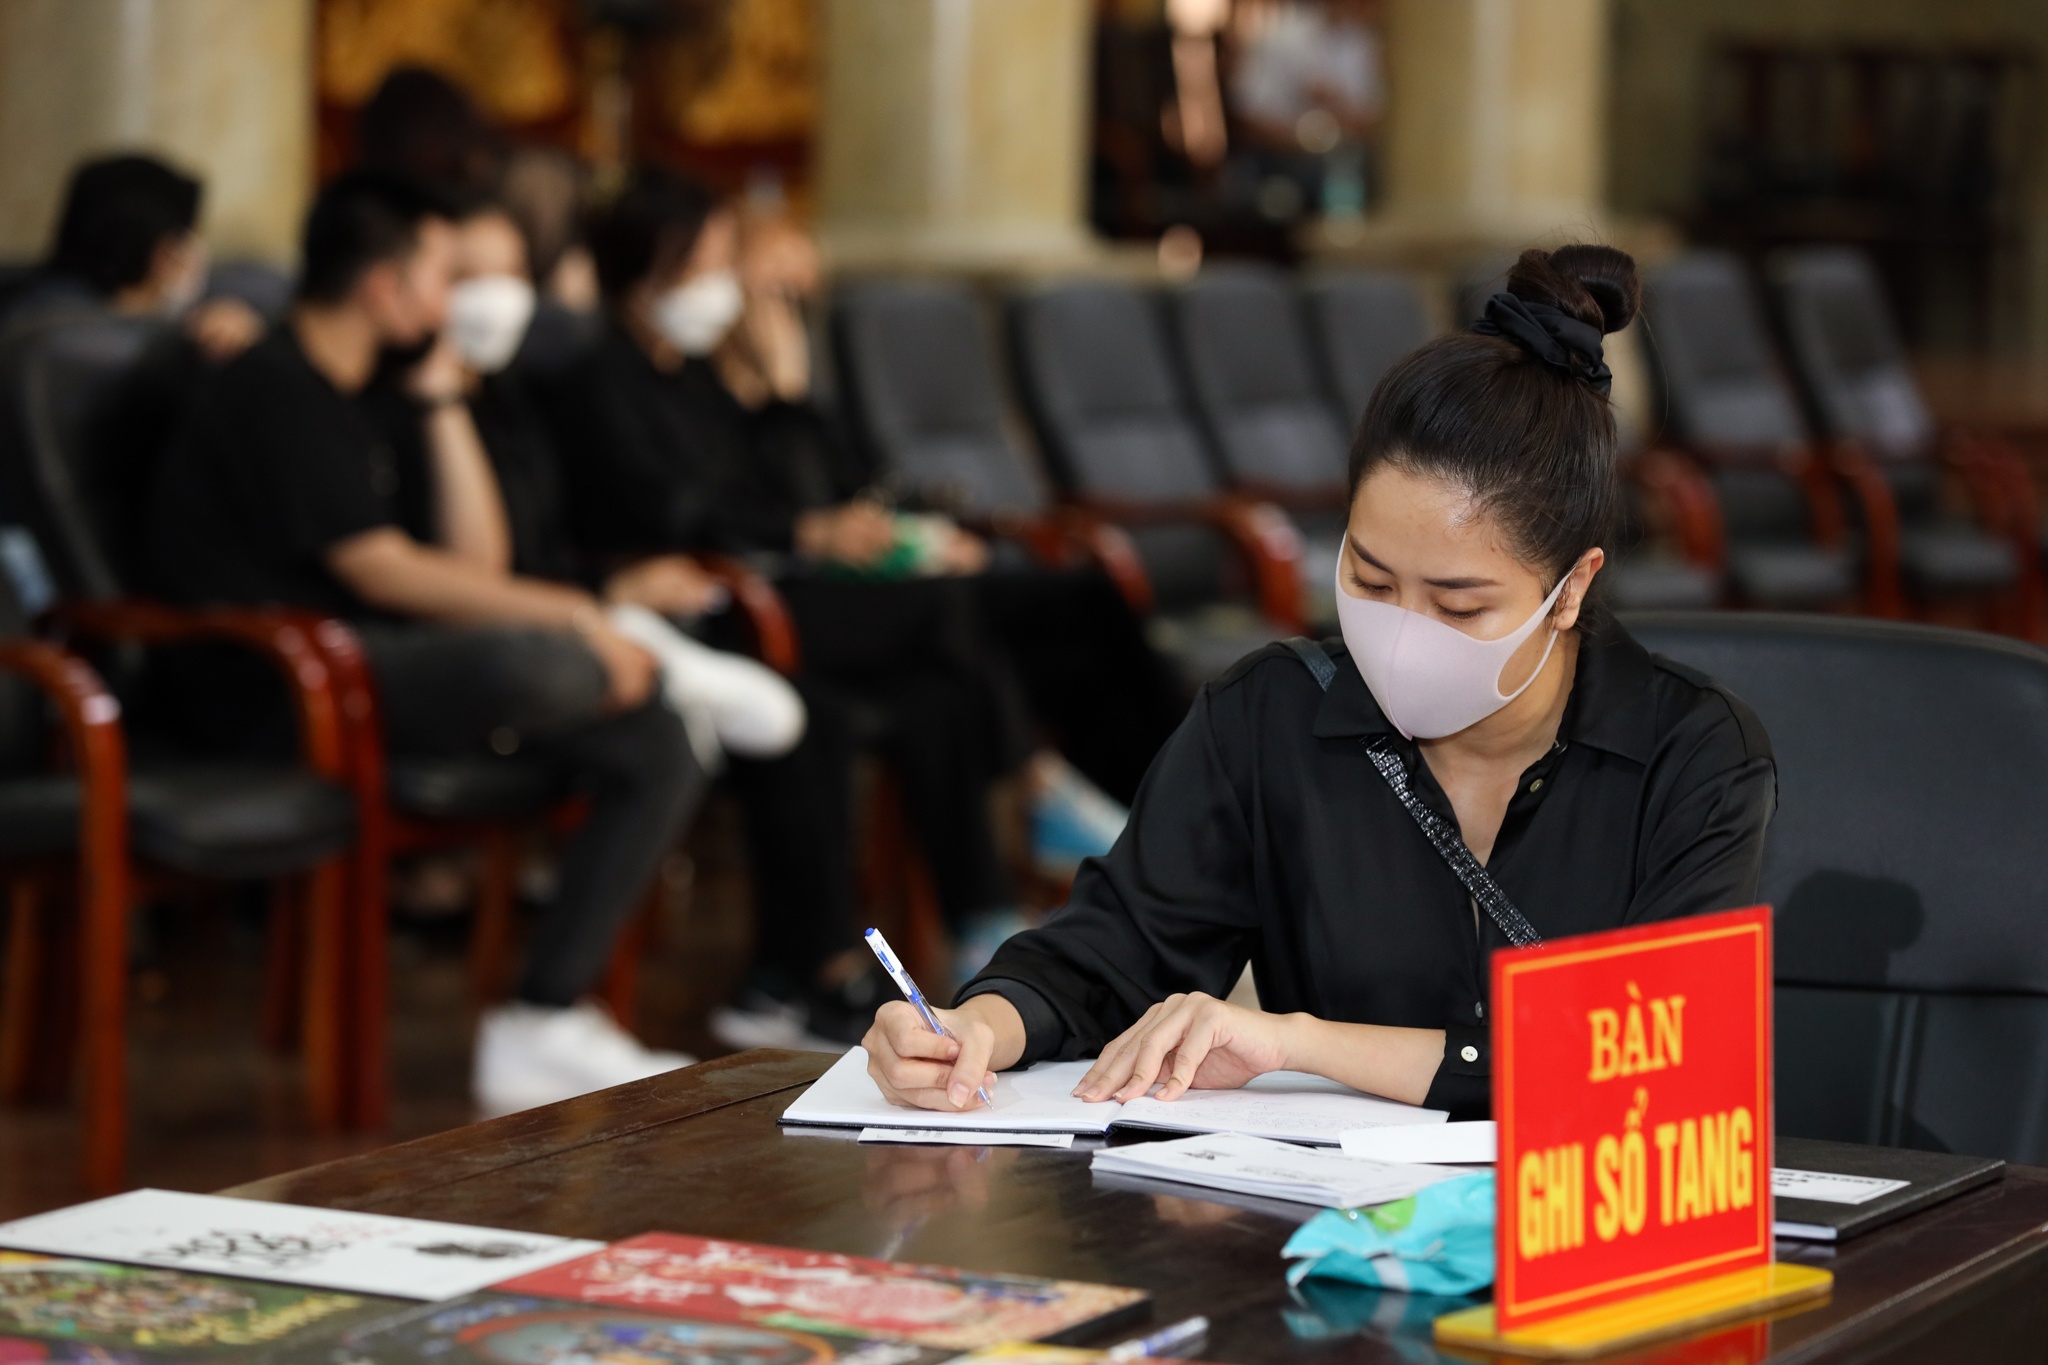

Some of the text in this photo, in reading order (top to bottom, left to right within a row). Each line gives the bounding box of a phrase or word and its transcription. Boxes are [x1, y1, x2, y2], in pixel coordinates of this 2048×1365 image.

[1588, 981, 1685, 1082] BÀN
[1518, 1087, 1753, 1260] GHI SỔ TANG
